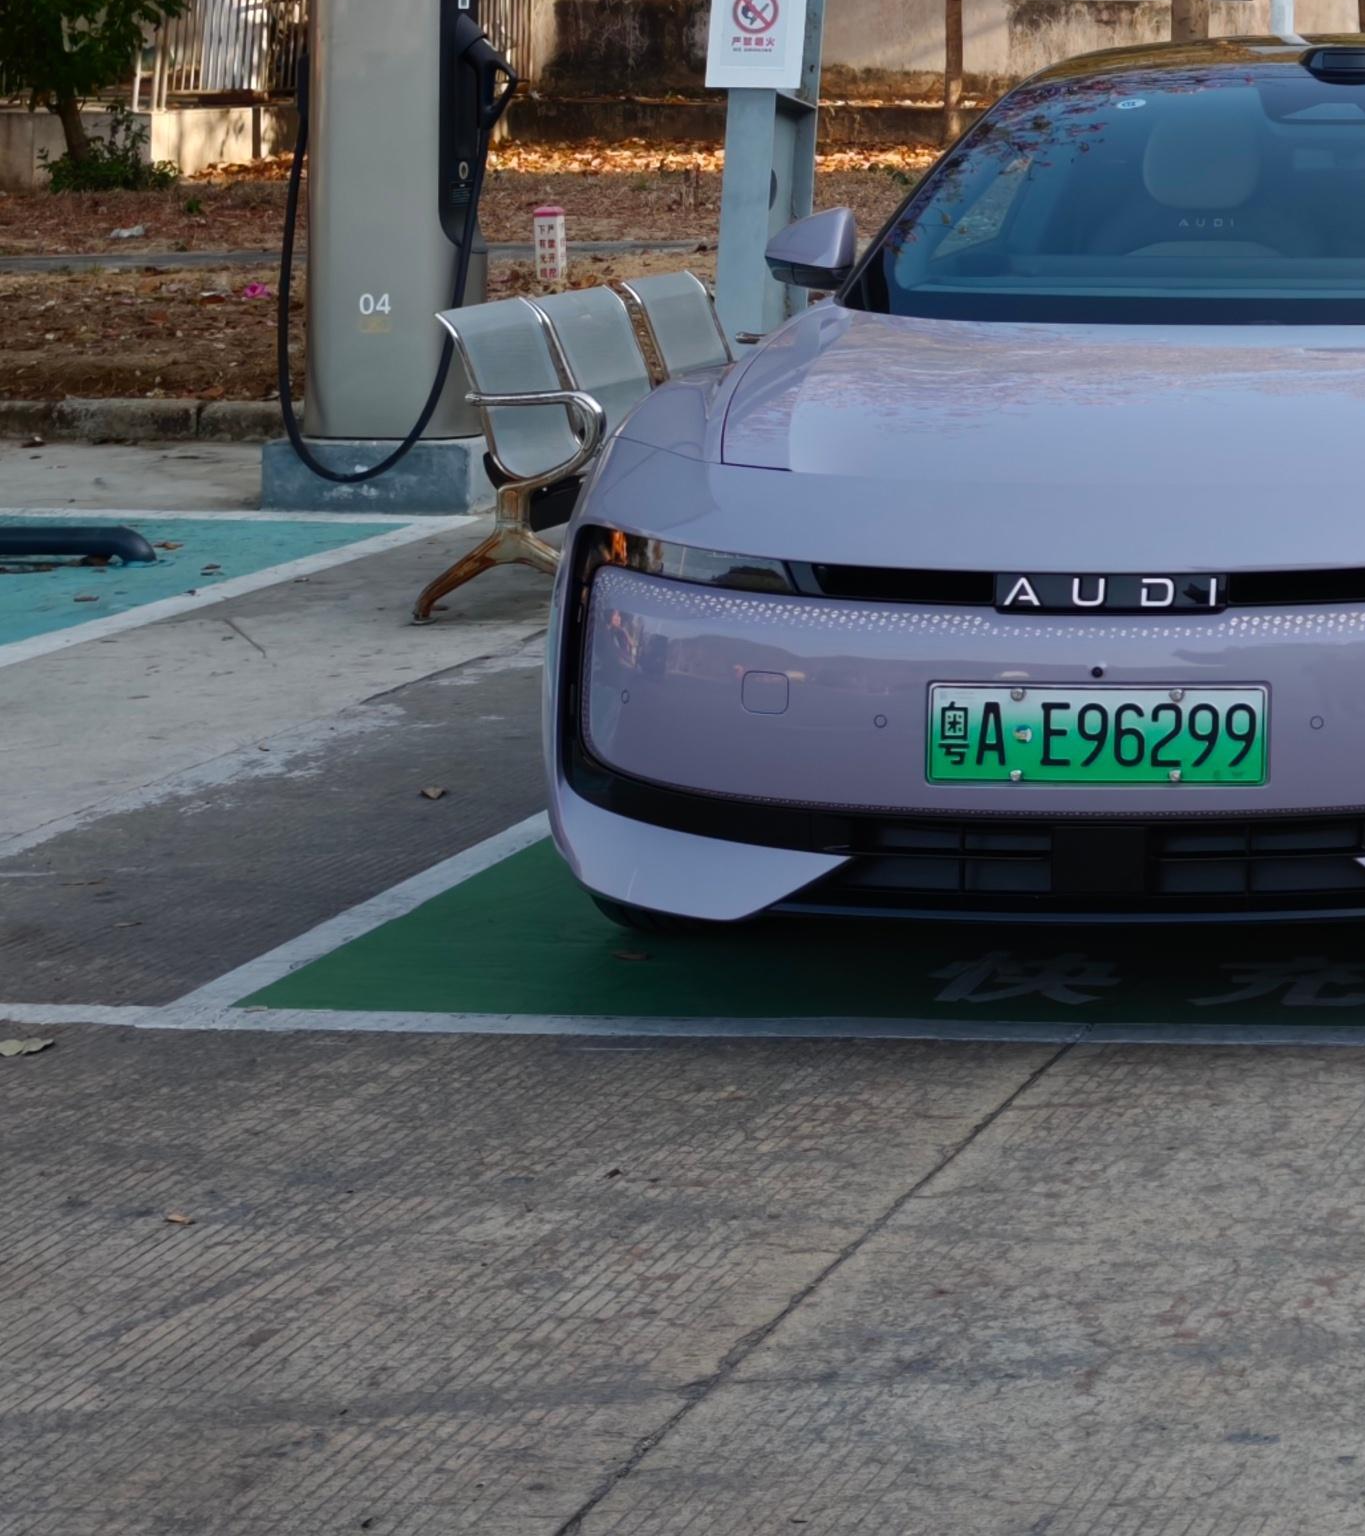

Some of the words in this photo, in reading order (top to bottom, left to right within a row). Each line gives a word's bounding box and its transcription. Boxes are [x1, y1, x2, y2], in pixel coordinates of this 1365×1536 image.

[1178, 217, 1235, 228] AUDI
[359, 293, 392, 315] 04
[1003, 576, 1218, 607] AUDI
